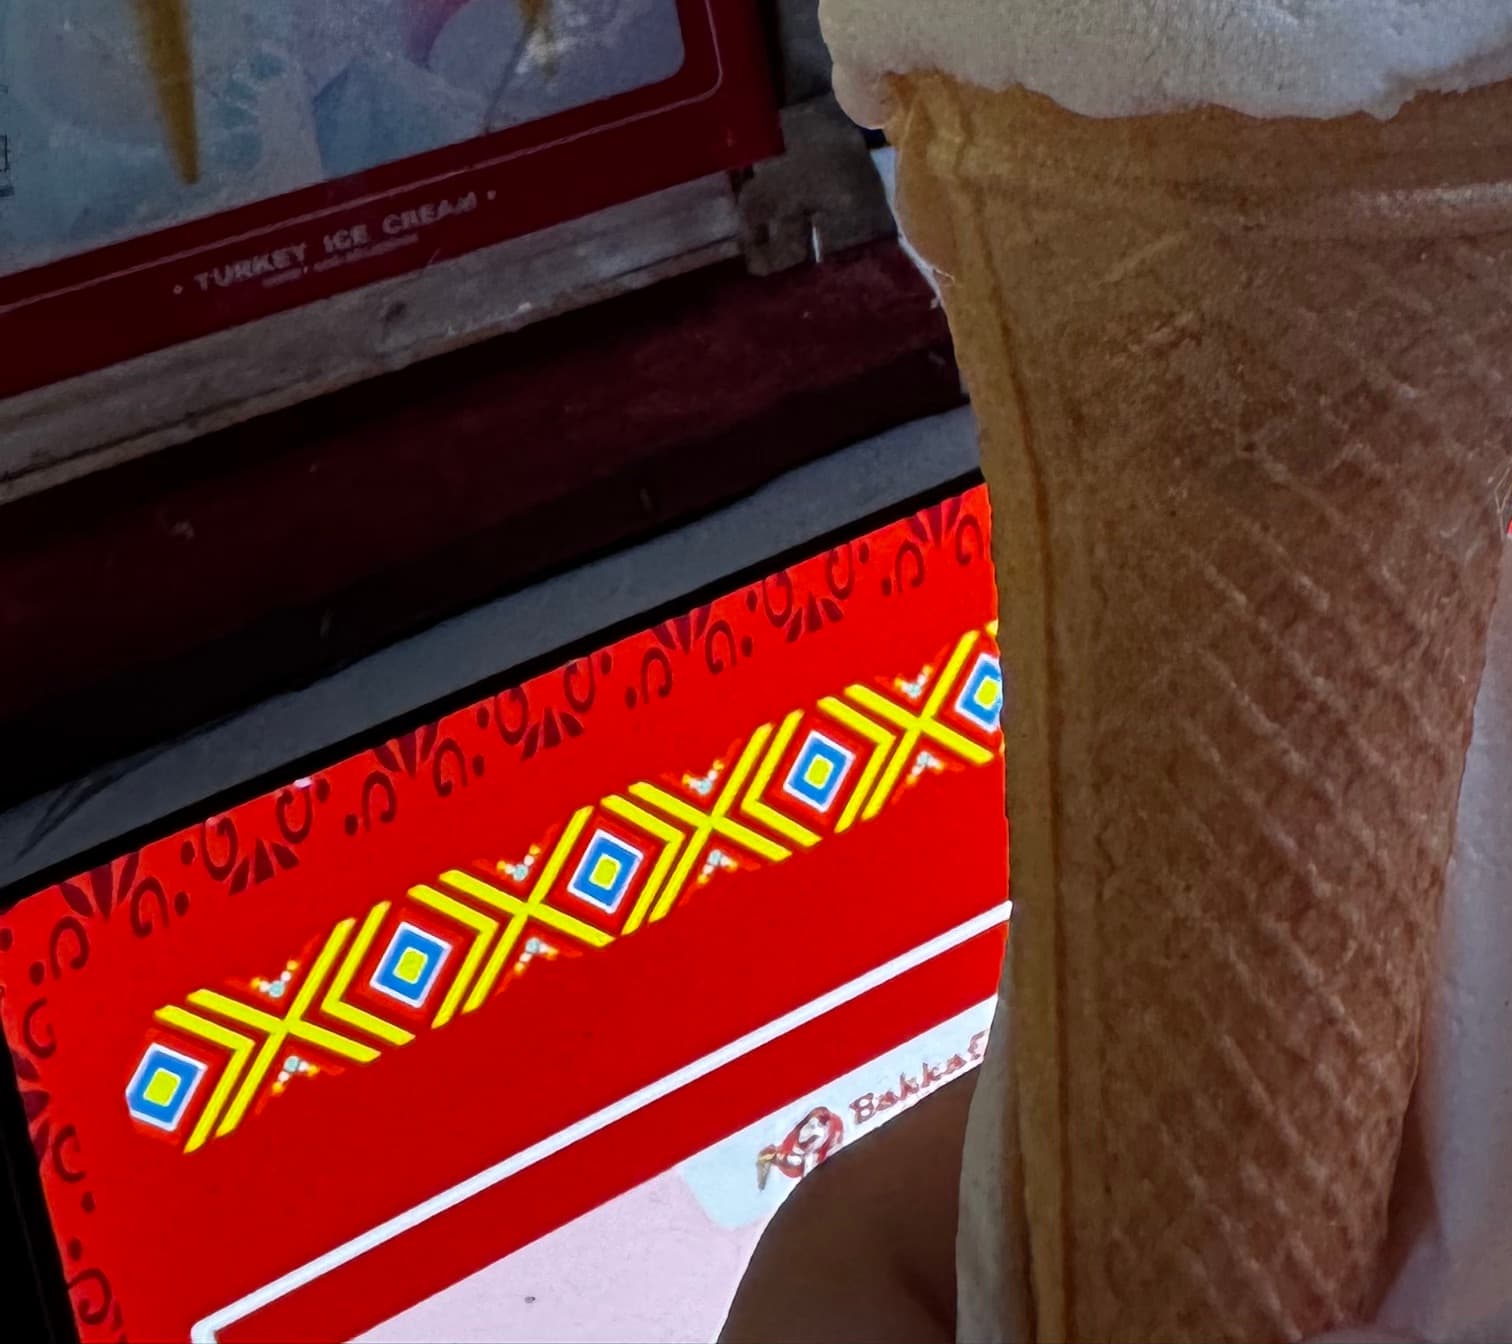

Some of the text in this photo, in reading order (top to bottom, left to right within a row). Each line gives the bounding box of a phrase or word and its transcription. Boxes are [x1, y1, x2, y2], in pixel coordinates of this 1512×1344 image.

[195, 242, 307, 291] TURKEY
[323, 225, 370, 252] ICE
[381, 190, 479, 235] CREAM
